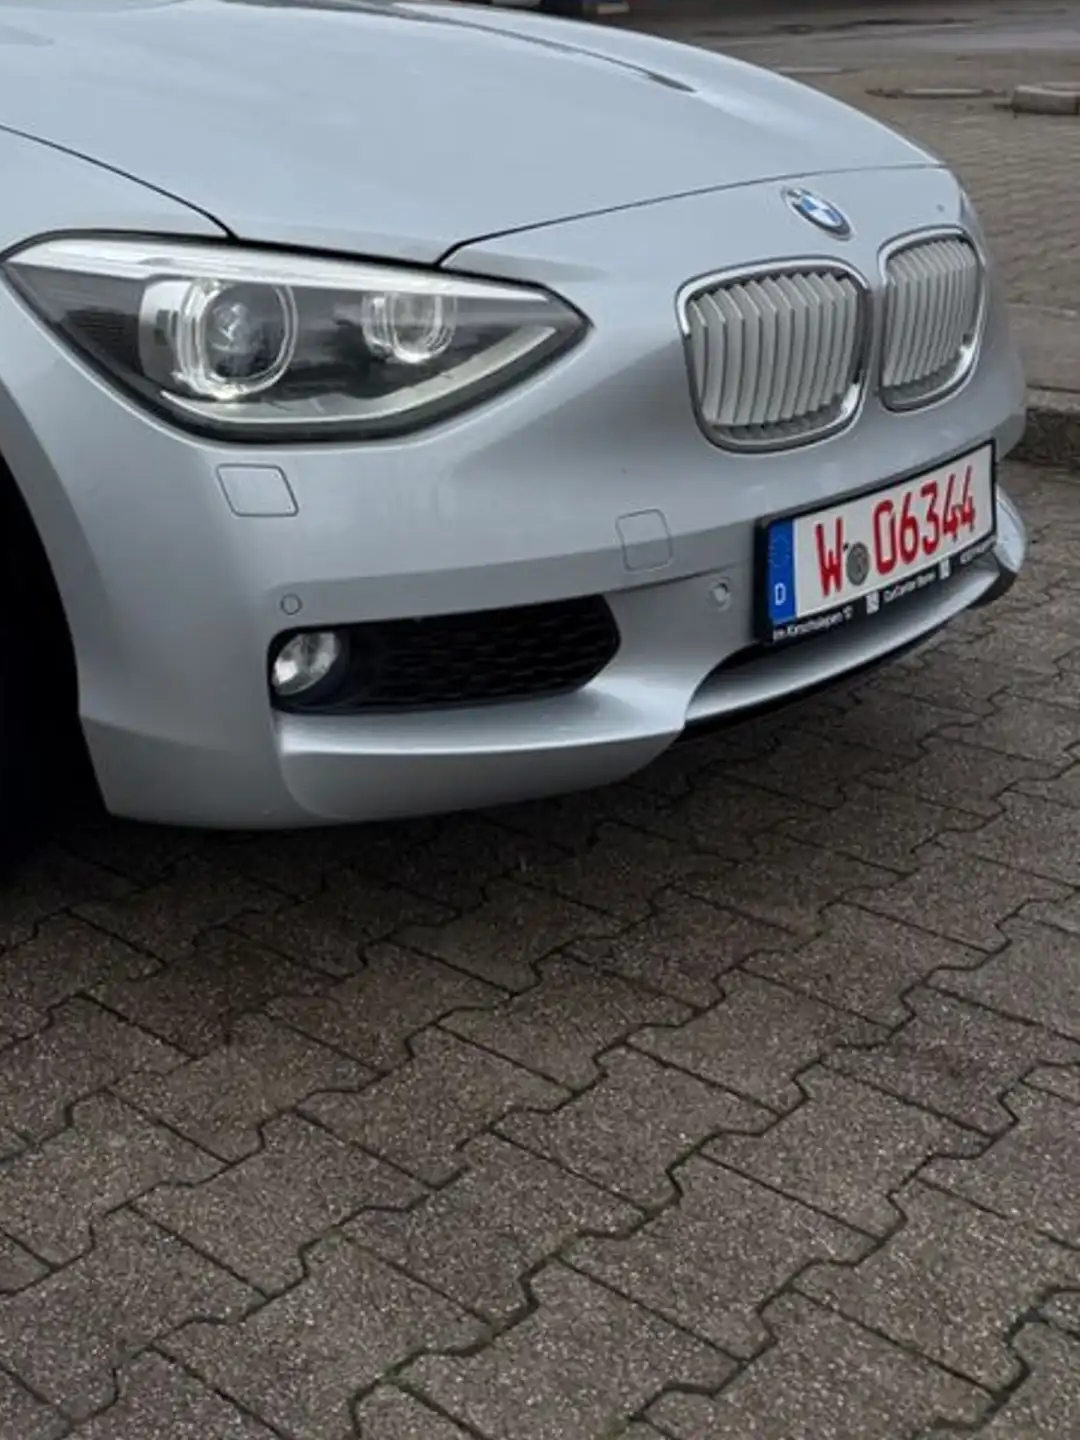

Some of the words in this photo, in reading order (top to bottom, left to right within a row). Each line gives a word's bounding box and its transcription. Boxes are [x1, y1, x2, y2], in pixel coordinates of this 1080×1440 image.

[815, 516, 844, 597] W
[873, 464, 976, 576] 06344
[774, 582, 787, 606] D
